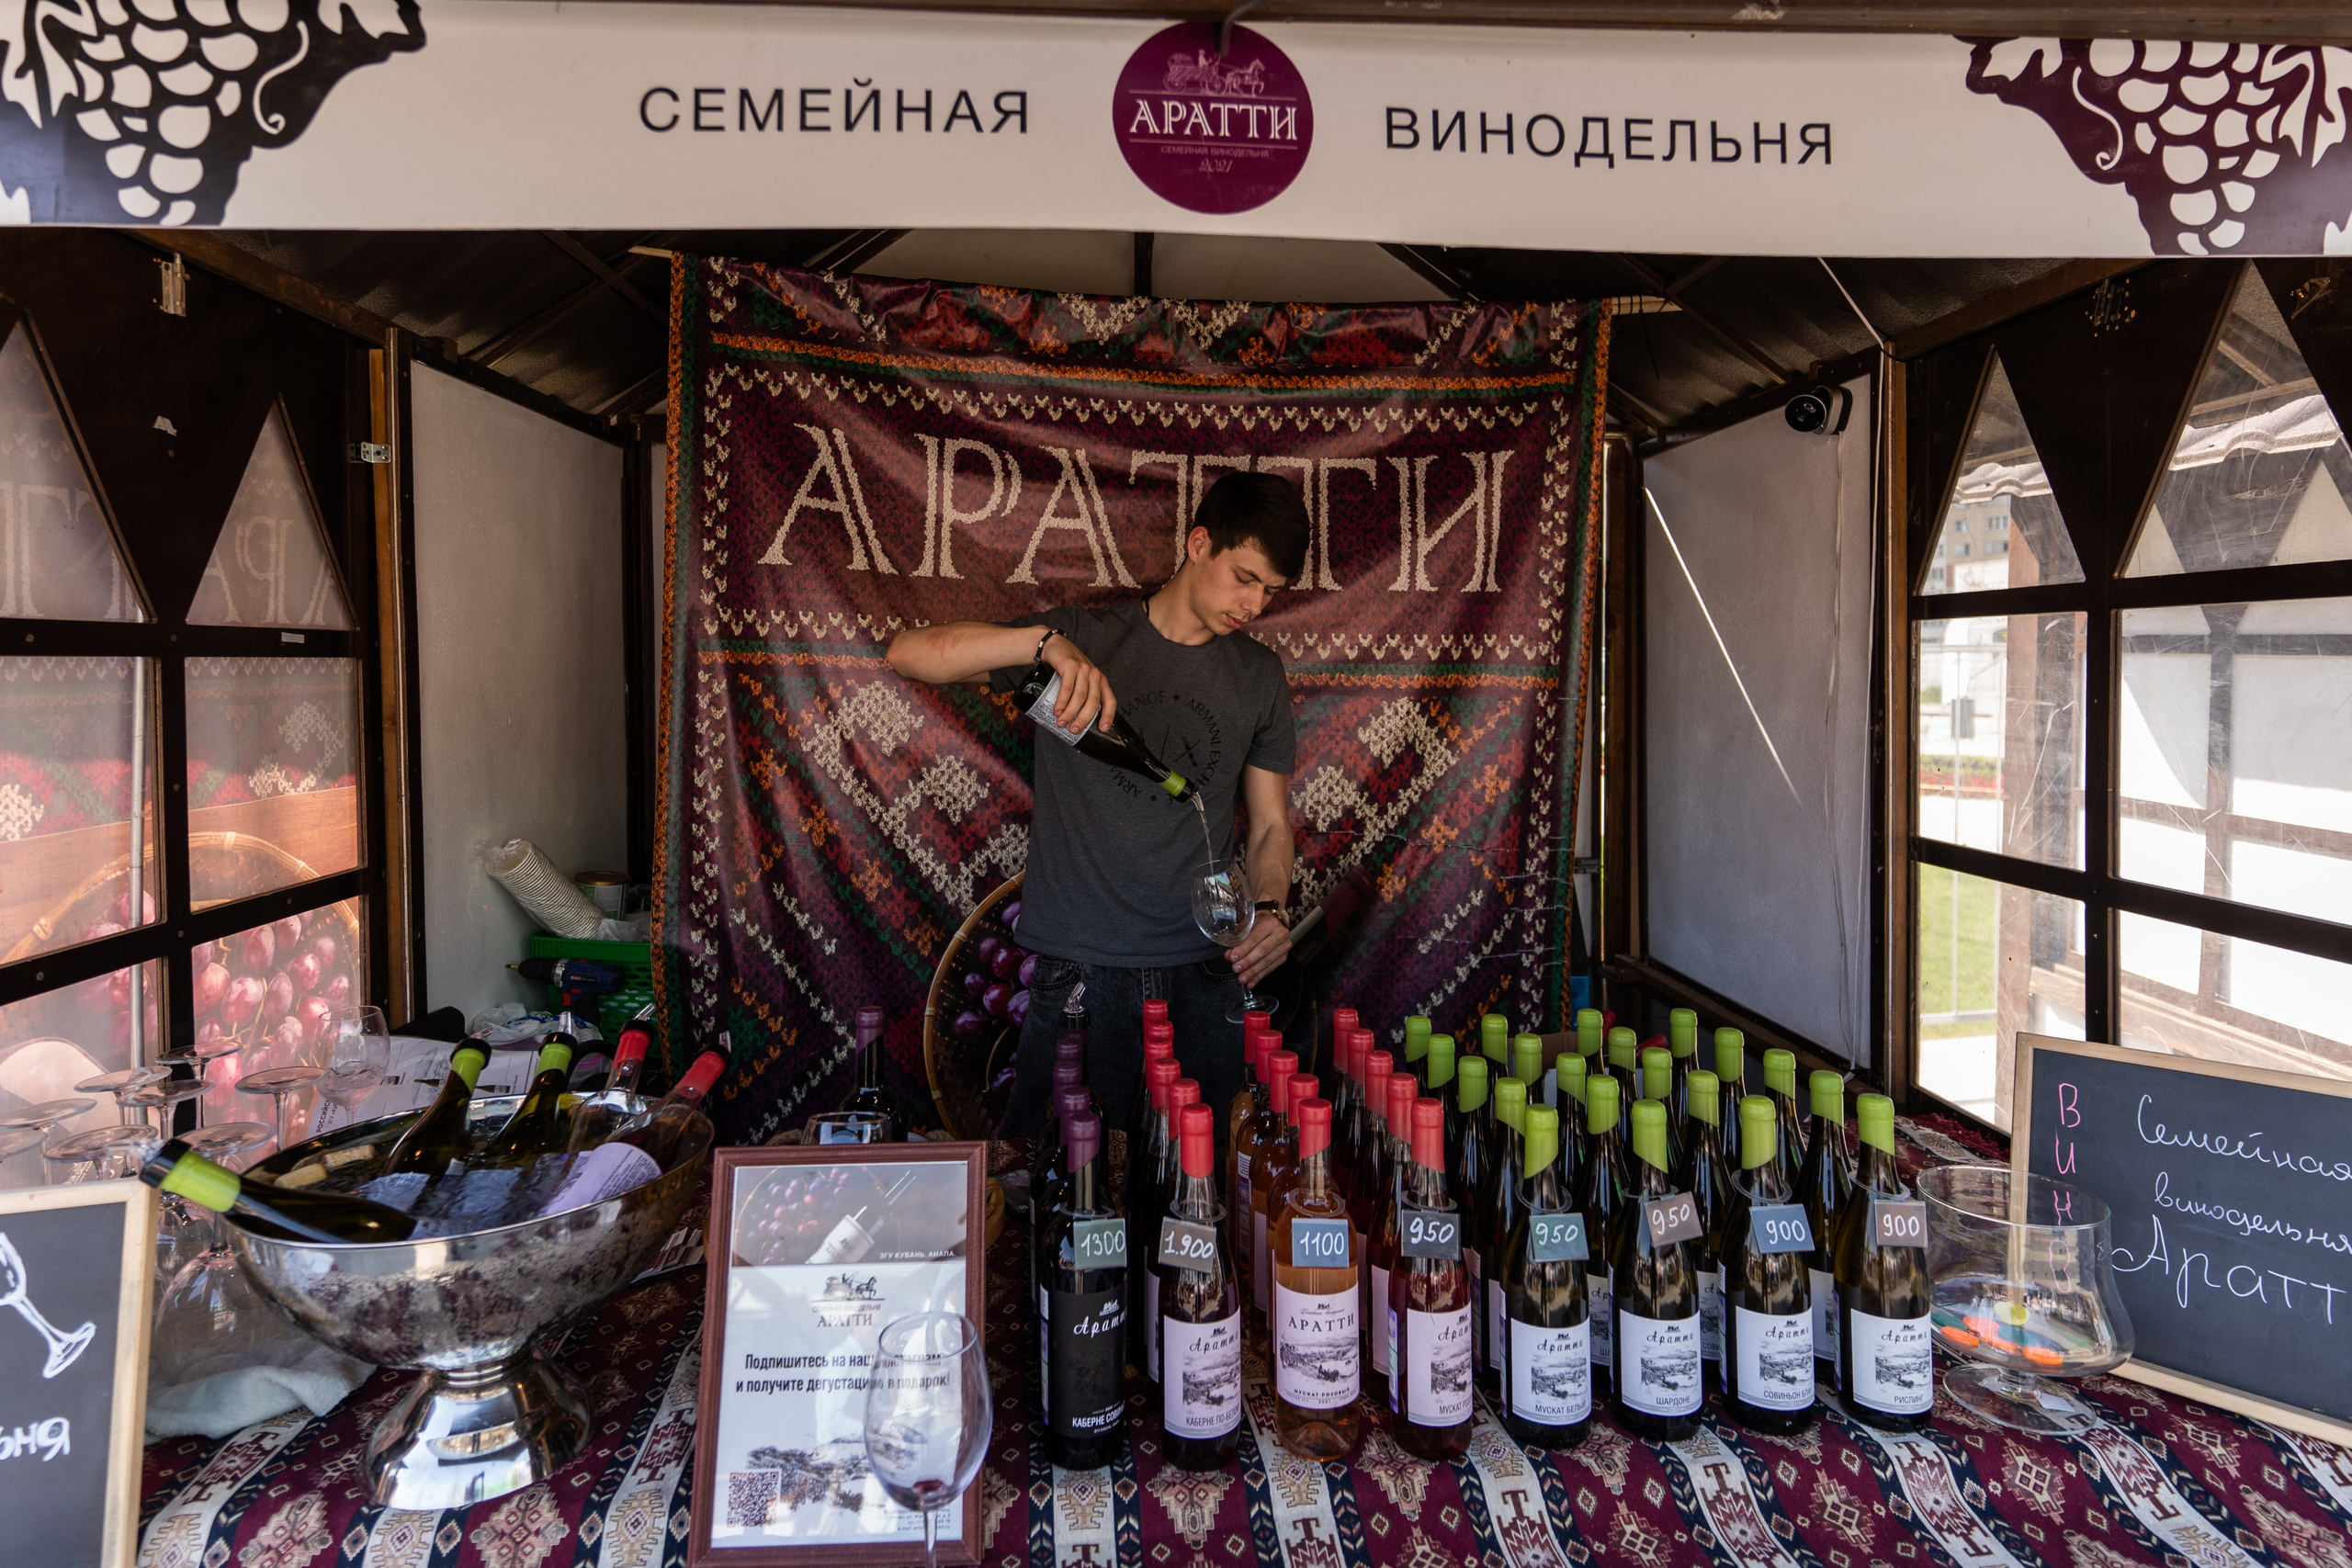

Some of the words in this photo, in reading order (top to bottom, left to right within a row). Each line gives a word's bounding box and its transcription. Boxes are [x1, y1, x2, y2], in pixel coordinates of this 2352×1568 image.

[640, 77, 1027, 133] СЕМЕЙНАЯ
[1385, 107, 1831, 169] ВИНОДЕЛЬНЯ
[1129, 98, 1298, 141] АРАТТИ
[1160, 146, 1208, 155] СЕМЕЙНАЯ
[1210, 147, 1269, 159] ВИНОДЕЛЬНЯ
[1198, 158, 1233, 173] 2021
[758, 423, 1515, 592] АРАТТИ
[1183, 698, 1223, 746] ARMANI
[2137, 1093, 2352, 1182] Семейная
[1652, 1203, 1691, 1235] 950
[1883, 1213, 1920, 1237] 900
[2154, 1171, 2352, 1256] винодельня
[1408, 1216, 1455, 1245] 950
[1535, 1223, 1578, 1246] 950
[1766, 1218, 1806, 1246] 900
[1080, 1229, 1125, 1258] 1300
[1163, 1230, 1215, 1259] 1.900
[1299, 1231, 1346, 1257] 1100
[1288, 1313, 1355, 1333] АРАТТИ
[745, 1354, 829, 1371] Подпишитесь
[831, 1355, 846, 1368] на
[736, 1381, 743, 1393] и
[746, 1378, 804, 1395] получите
[888, 1377, 896, 1389] в
[897, 1372, 950, 1391] подарок!
[1763, 1390, 1801, 1400] СОВИНЬОН
[1439, 1401, 1462, 1415] МУСКАТ
[1535, 1404, 1565, 1415] МУСКАТ
[1656, 1396, 1691, 1406] ШАРДОНЕ
[1071, 1414, 1105, 1427] КАБЕРНЕ
[1185, 1416, 1215, 1427] КАБЕРНЕ
